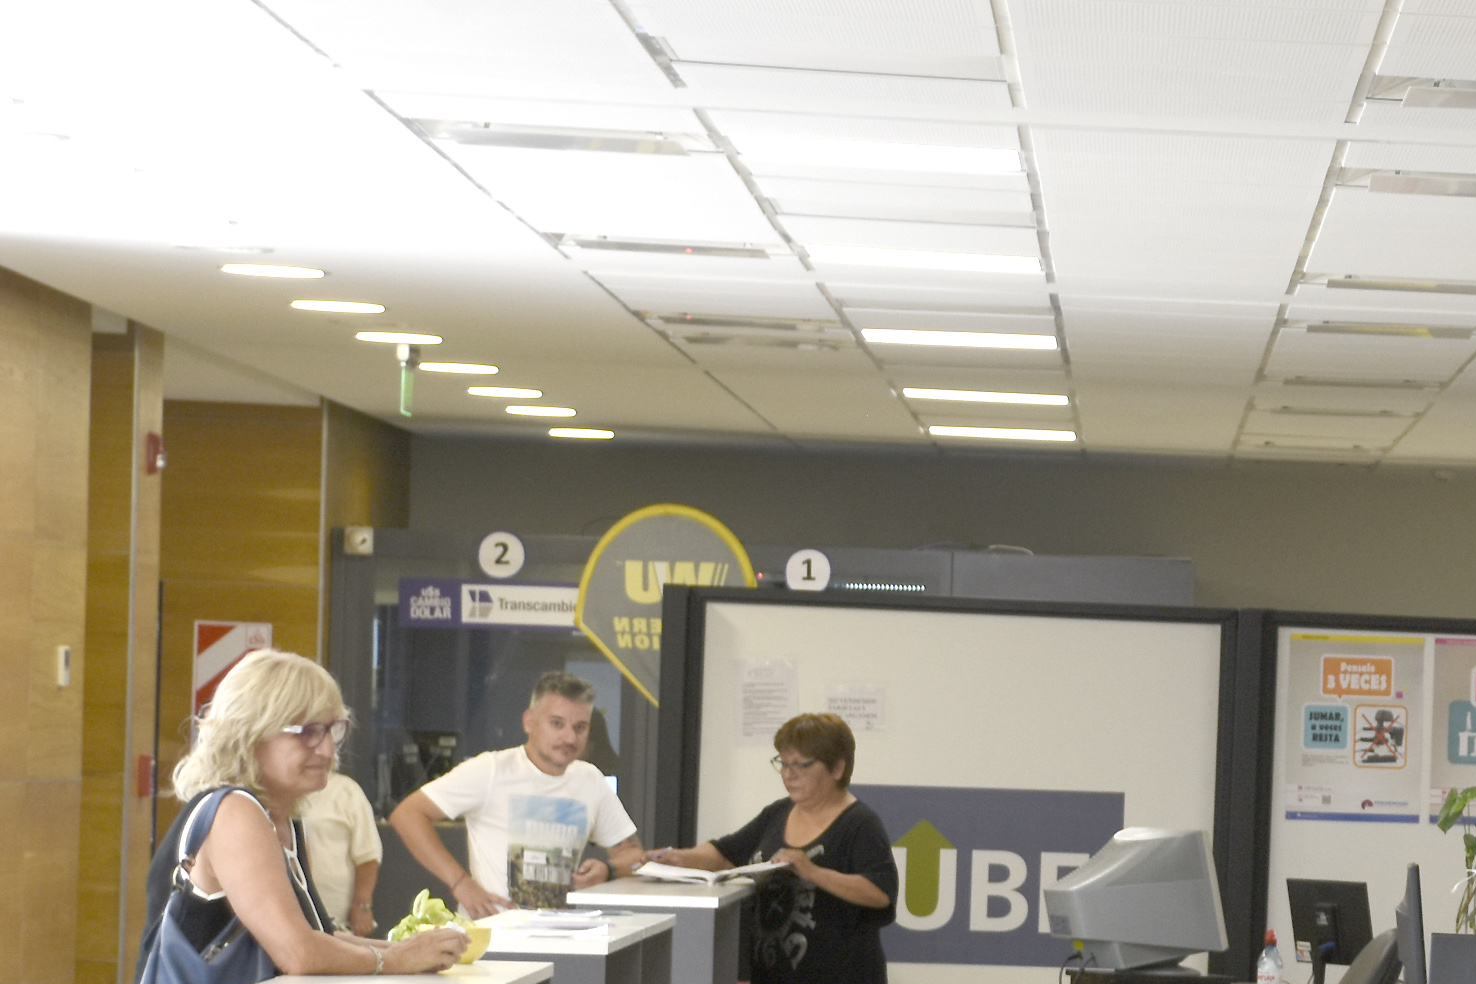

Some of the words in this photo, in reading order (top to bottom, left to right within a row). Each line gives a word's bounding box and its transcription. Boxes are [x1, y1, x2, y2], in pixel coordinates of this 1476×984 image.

[493, 541, 511, 566] 2
[801, 558, 817, 581] 1
[410, 606, 452, 619] DOLAR
[1327, 674, 1336, 690] 3
[1339, 673, 1388, 691] VECES
[1309, 711, 1344, 723] SUMAR,
[1319, 723, 1342, 732] veces
[1312, 732, 1341, 744] RESTA
